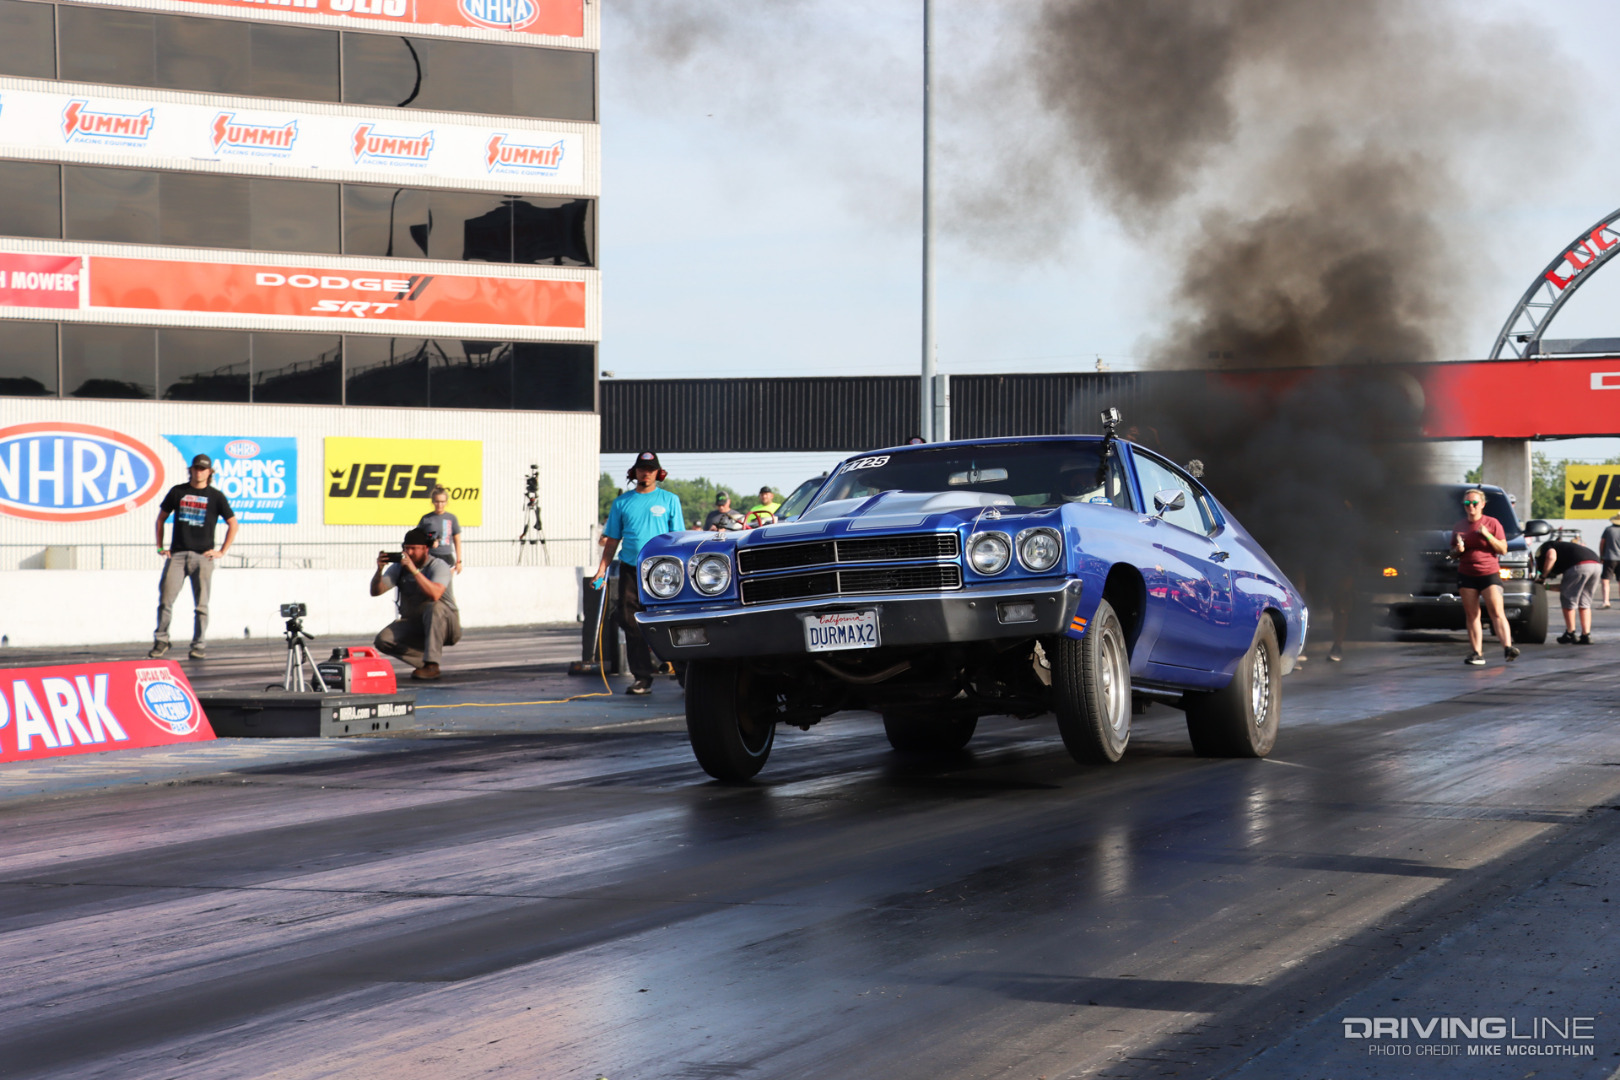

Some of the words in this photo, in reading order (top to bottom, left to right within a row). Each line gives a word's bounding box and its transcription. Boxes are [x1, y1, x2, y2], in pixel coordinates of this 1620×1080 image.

[470, 0, 528, 22] NHRA
[256, 273, 410, 292] DODGE
[310, 300, 398, 317] SRT
[229, 443, 256, 455] NHRA
[0, 439, 137, 506] NHRA
[211, 459, 285, 478] AMPING
[256, 500, 284, 509] SERIES
[820, 614, 864, 625] California
[810, 624, 875, 645] DURMAX2
[138, 670, 160, 681] LUCAS
[0, 673, 129, 753] ARK
